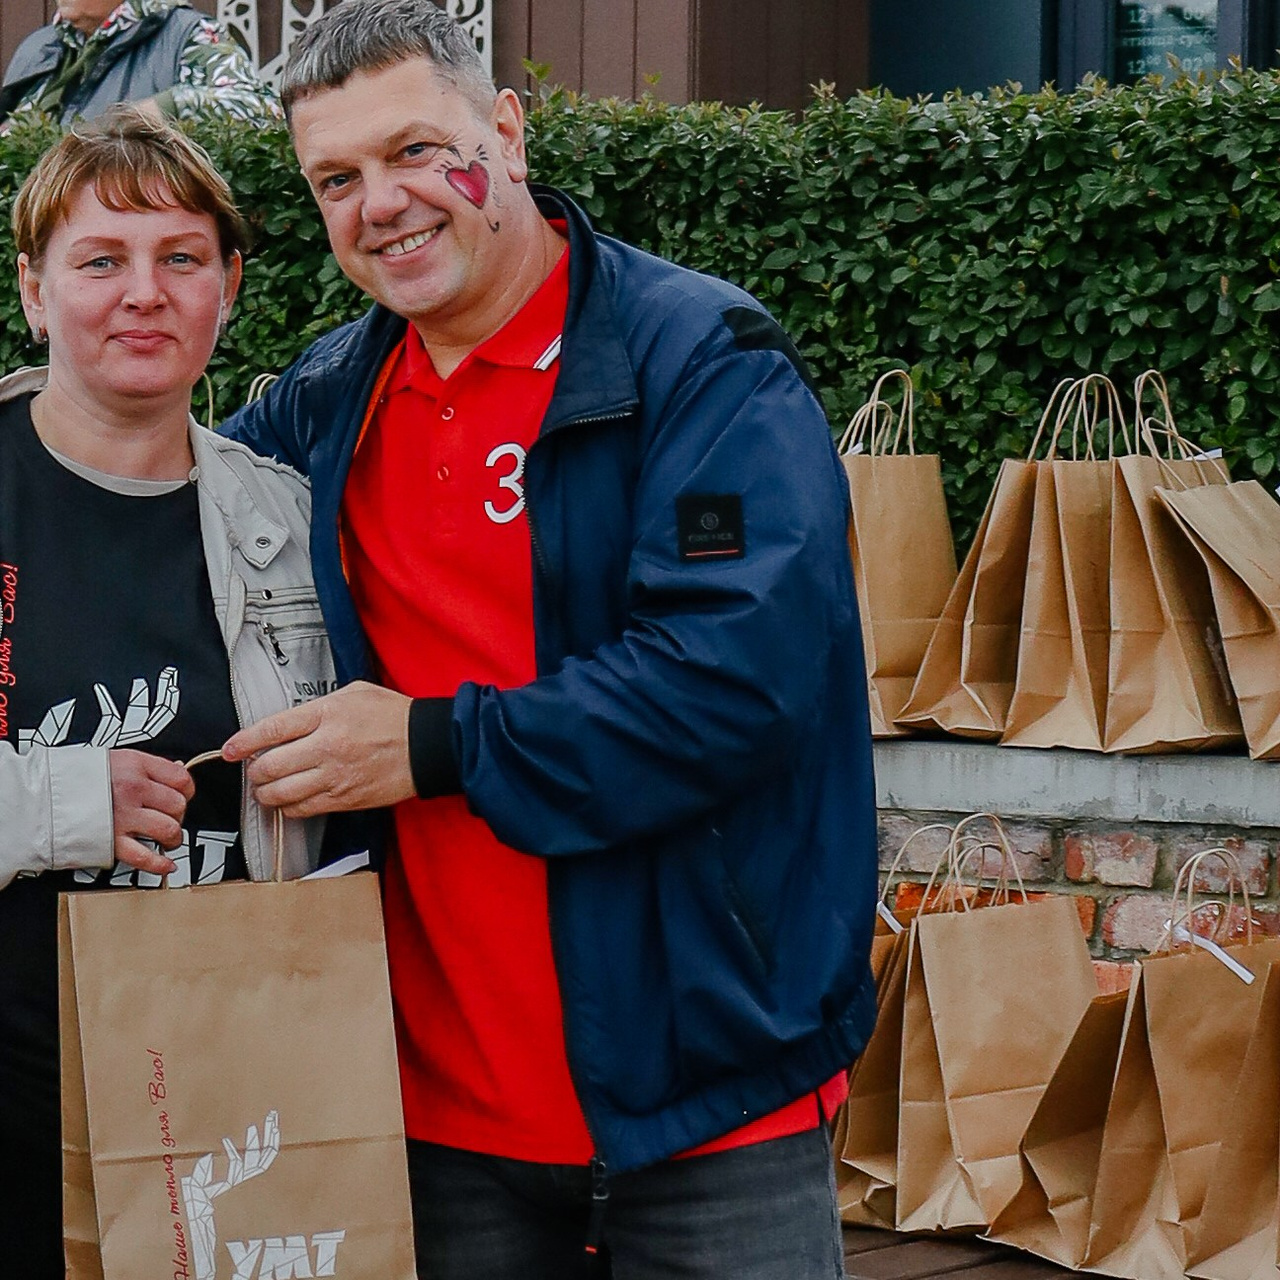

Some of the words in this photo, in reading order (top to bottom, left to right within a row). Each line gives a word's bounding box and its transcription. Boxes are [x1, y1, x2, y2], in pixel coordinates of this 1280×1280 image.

[484, 442, 527, 524] 3
[146, 1047, 167, 1106] Вас!
[160, 1110, 176, 1149] для
